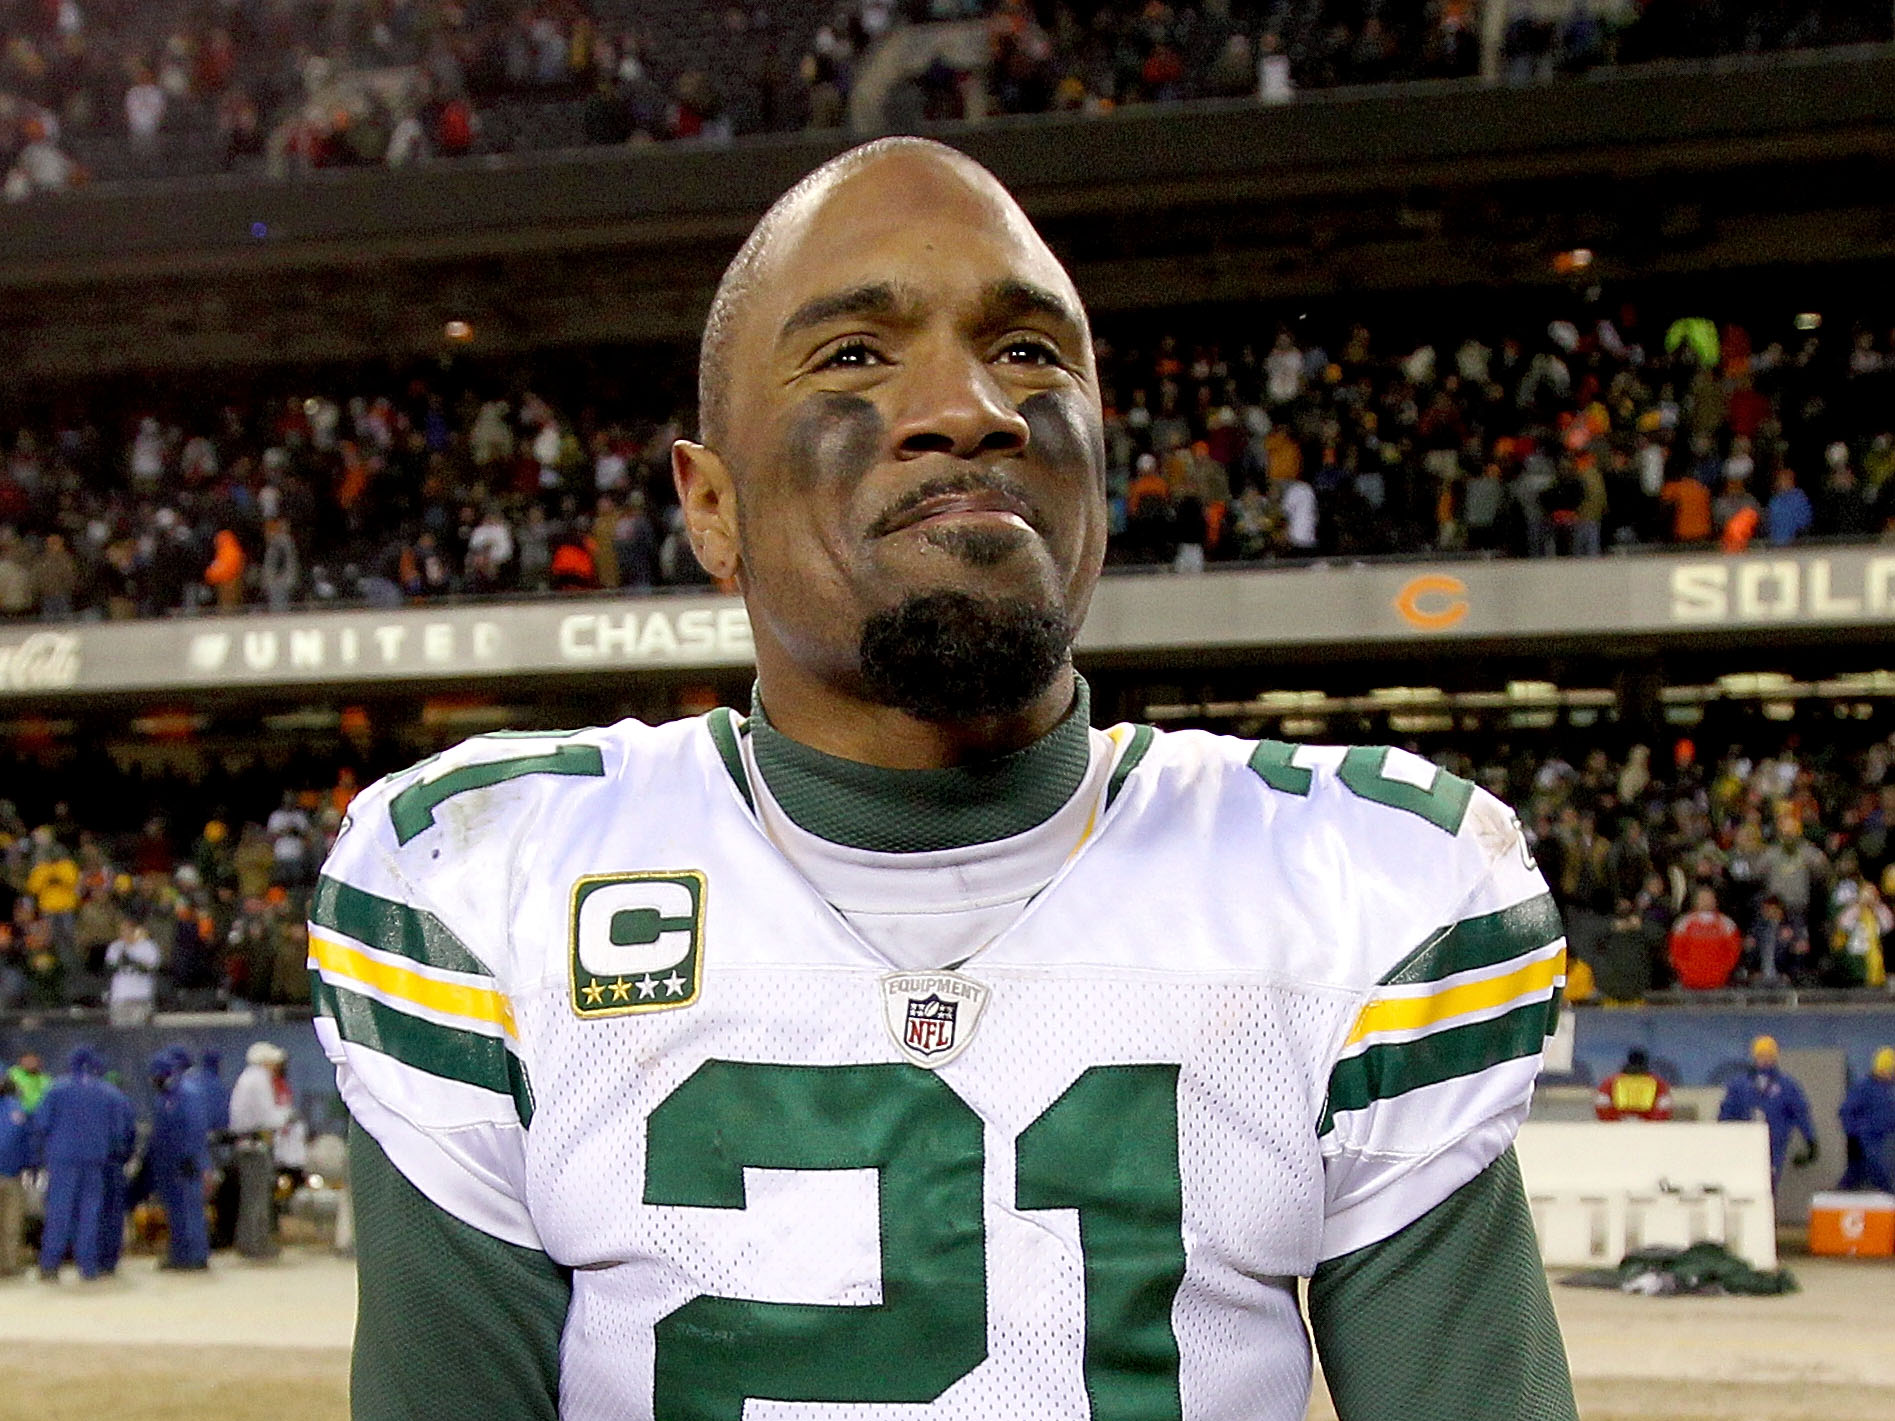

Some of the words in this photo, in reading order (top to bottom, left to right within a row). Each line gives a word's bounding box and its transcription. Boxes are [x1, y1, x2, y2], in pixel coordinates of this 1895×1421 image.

[561, 608, 753, 661] CHASE
[579, 882, 693, 976] C
[888, 978, 981, 1003] EQUIPMENT
[908, 1019, 949, 1050] NFL
